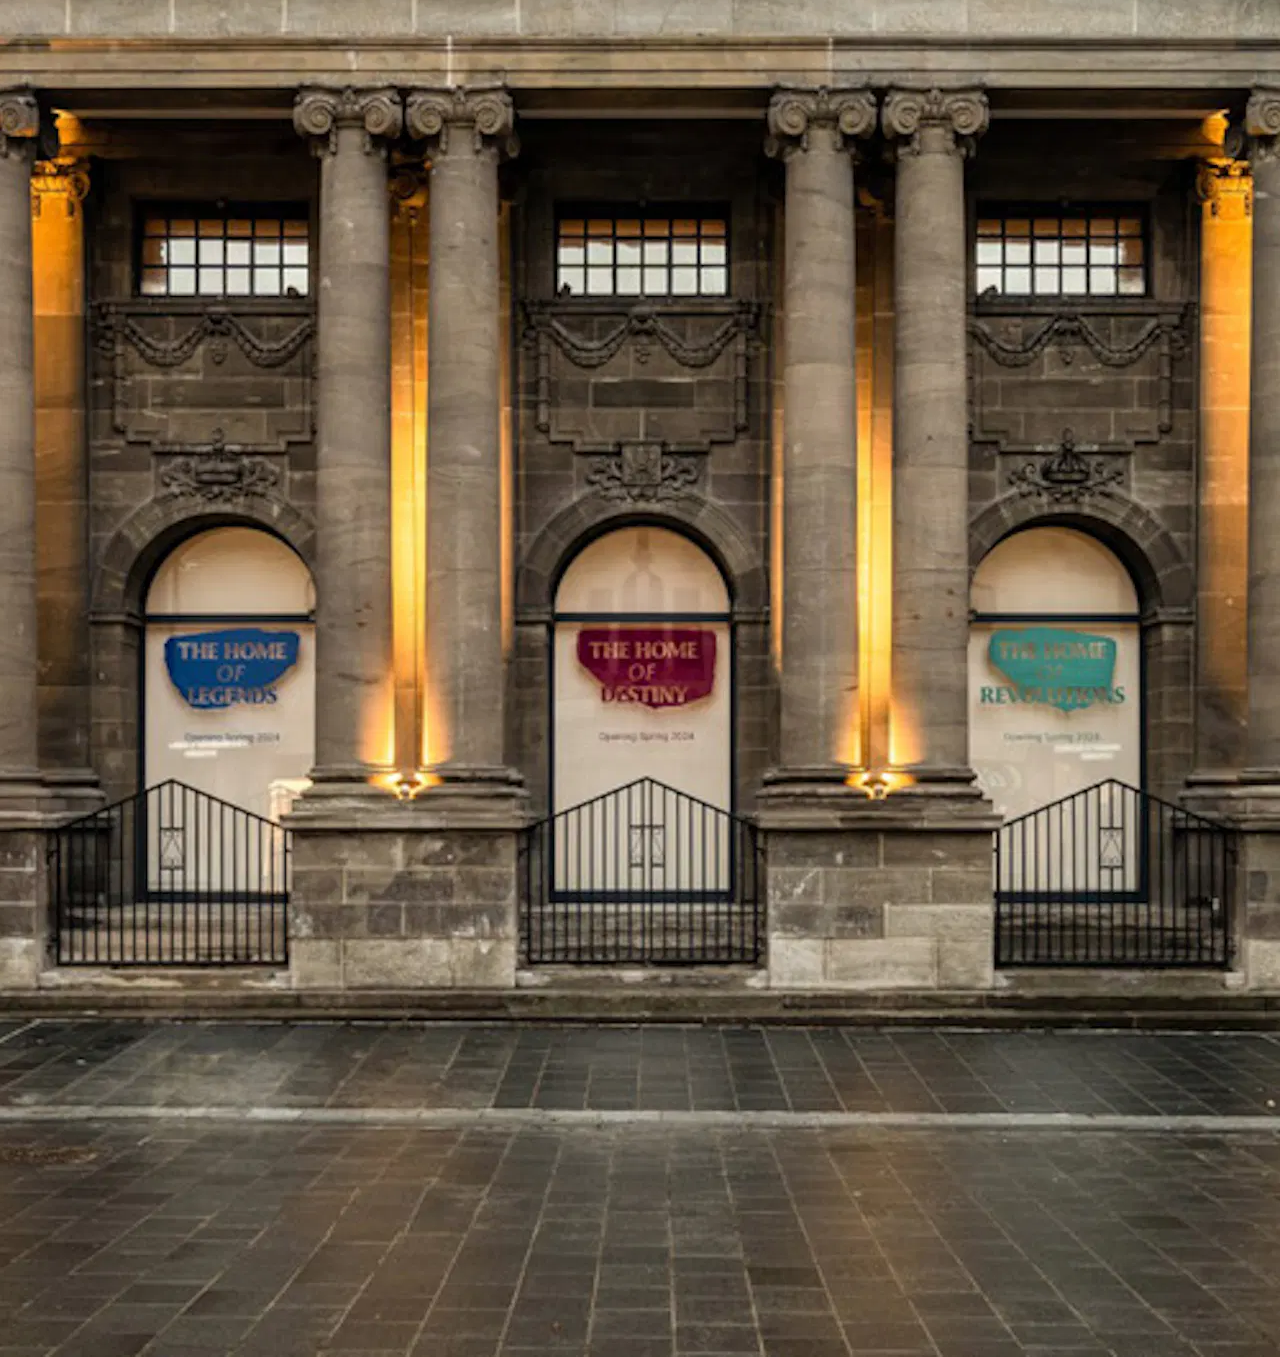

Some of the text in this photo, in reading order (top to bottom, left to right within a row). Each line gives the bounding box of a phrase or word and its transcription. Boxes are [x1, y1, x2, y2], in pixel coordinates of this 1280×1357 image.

[177, 642, 287, 660] THE HOME
[588, 641, 699, 660] THE HOME
[998, 642, 1107, 660] THE HOME
[216, 665, 246, 683] OF
[629, 663, 656, 682] OF
[188, 686, 277, 705] LEGENDS
[601, 685, 688, 703] DESTINY
